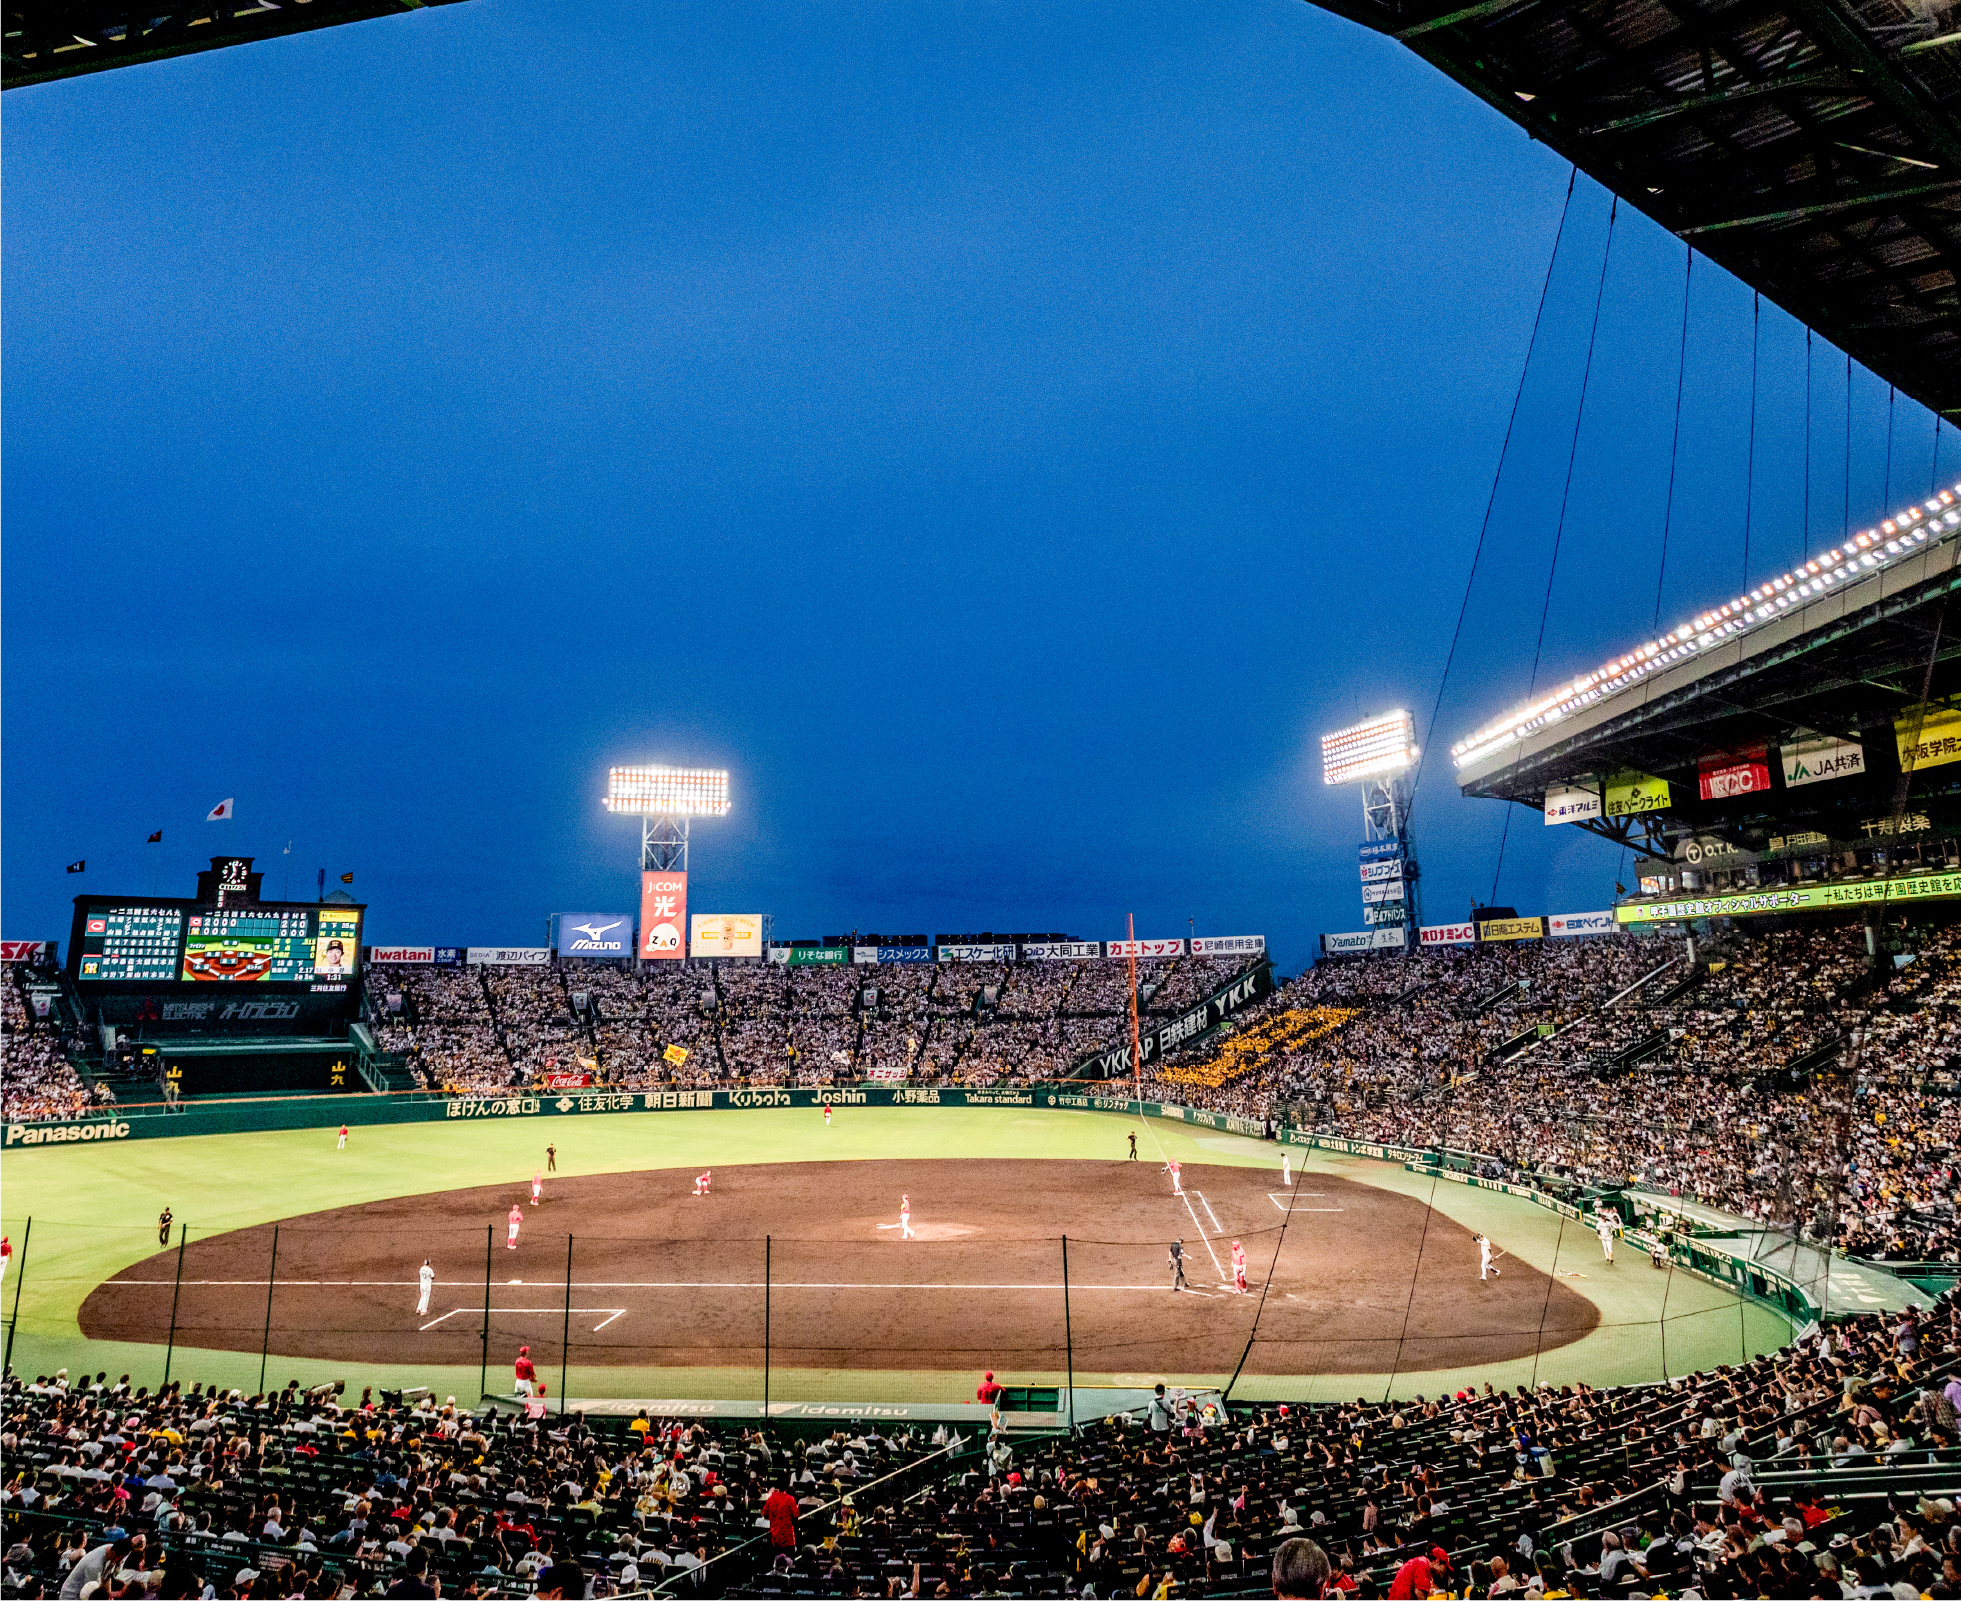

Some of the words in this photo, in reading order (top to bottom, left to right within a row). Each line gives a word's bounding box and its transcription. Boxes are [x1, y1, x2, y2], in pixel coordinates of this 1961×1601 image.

[1903, 736, 1961, 762] 大阪学院
[1813, 753, 1861, 776] JA共済
[1712, 771, 1753, 797] ECC
[1559, 800, 1598, 816] 東洋アルミ
[1608, 794, 1668, 815] 住友ベークライト
[1786, 831, 1828, 846] 戸田建設
[1704, 842, 1739, 856] O.T.K.
[219, 883, 247, 891] CITIZEN
[648, 882, 682, 894] J:COM
[654, 896, 677, 917] 光
[1650, 892, 1810, 918] 甲子園歴史館オフィシャルサポーター
[1491, 922, 1540, 936] 日商エステム
[1566, 915, 1613, 930] 日本ペイント
[651, 935, 677, 948] ZAQ
[1331, 935, 1365, 948] Yamato
[1421, 926, 1473, 942] オロナミンC
[570, 939, 621, 950] MIZUNO
[954, 945, 1014, 959] エスケー化研
[1047, 943, 1099, 958] 大同工業
[1109, 940, 1181, 956] カニトップ
[1204, 938, 1264, 951] 尼崎信用金庫
[374, 949, 432, 961] Iwatani
[437, 949, 457, 959] 水素
[798, 950, 843, 960] りそな銀行
[879, 949, 929, 960] シスメックス
[1214, 975, 1257, 1016] YKK
[163, 1003, 215, 1011] MITSUBISHI
[162, 1011, 207, 1020] ELECTRIC
[1159, 1006, 1208, 1051] 日鉄建材
[1100, 1046, 1132, 1078] YKK
[1134, 1037, 1154, 1065] AP
[166, 1066, 183, 1093] 山九
[331, 1061, 346, 1086] 山九
[868, 1070, 907, 1078] 不二サッシ
[578, 1095, 634, 1112] 住友化学
[645, 1092, 712, 1108] 朝日新聞
[728, 1091, 791, 1107] Kubota
[811, 1089, 867, 1104] Joshin
[892, 1090, 940, 1104] 小野薬品
[965, 1093, 993, 1103] Takara
[994, 1094, 1032, 1104] standard
[446, 1100, 534, 1118] ほけんの窓口
[1103, 1099, 1129, 1110] リンテック
[6, 1120, 130, 1145] Panasonic
[608, 1402, 715, 1413] idemitsu
[799, 1404, 908, 1416] idemitsu
